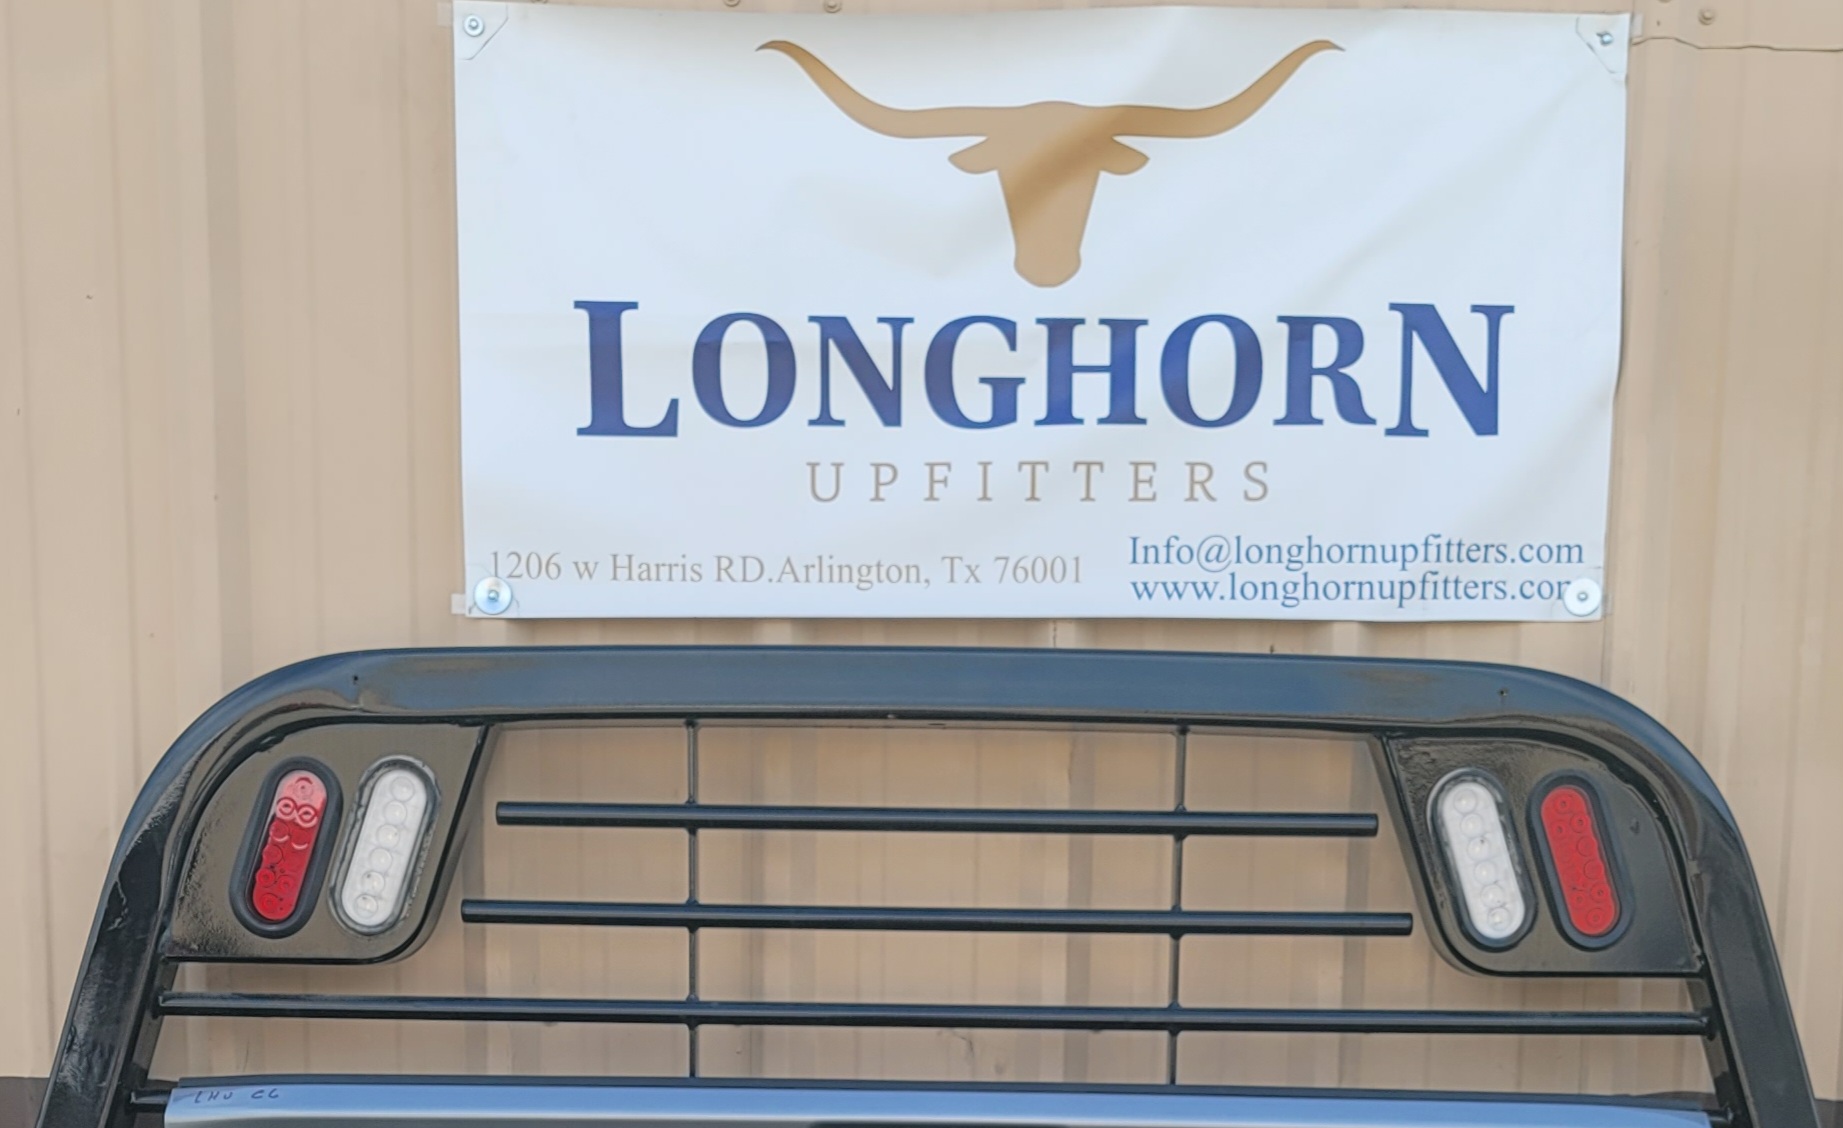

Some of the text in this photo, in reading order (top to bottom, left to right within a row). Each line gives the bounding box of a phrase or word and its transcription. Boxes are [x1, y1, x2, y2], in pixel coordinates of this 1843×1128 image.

[573, 300, 1515, 438] LONGHORN
[806, 461, 1269, 502] UPFITTERS
[490, 550, 562, 580] 1206
[572, 559, 600, 581] w
[609, 553, 704, 583] Harris
[941, 555, 982, 583] Tx
[994, 555, 1083, 584] 76001
[1128, 533, 1585, 573] Info@longhornupfitters.com
